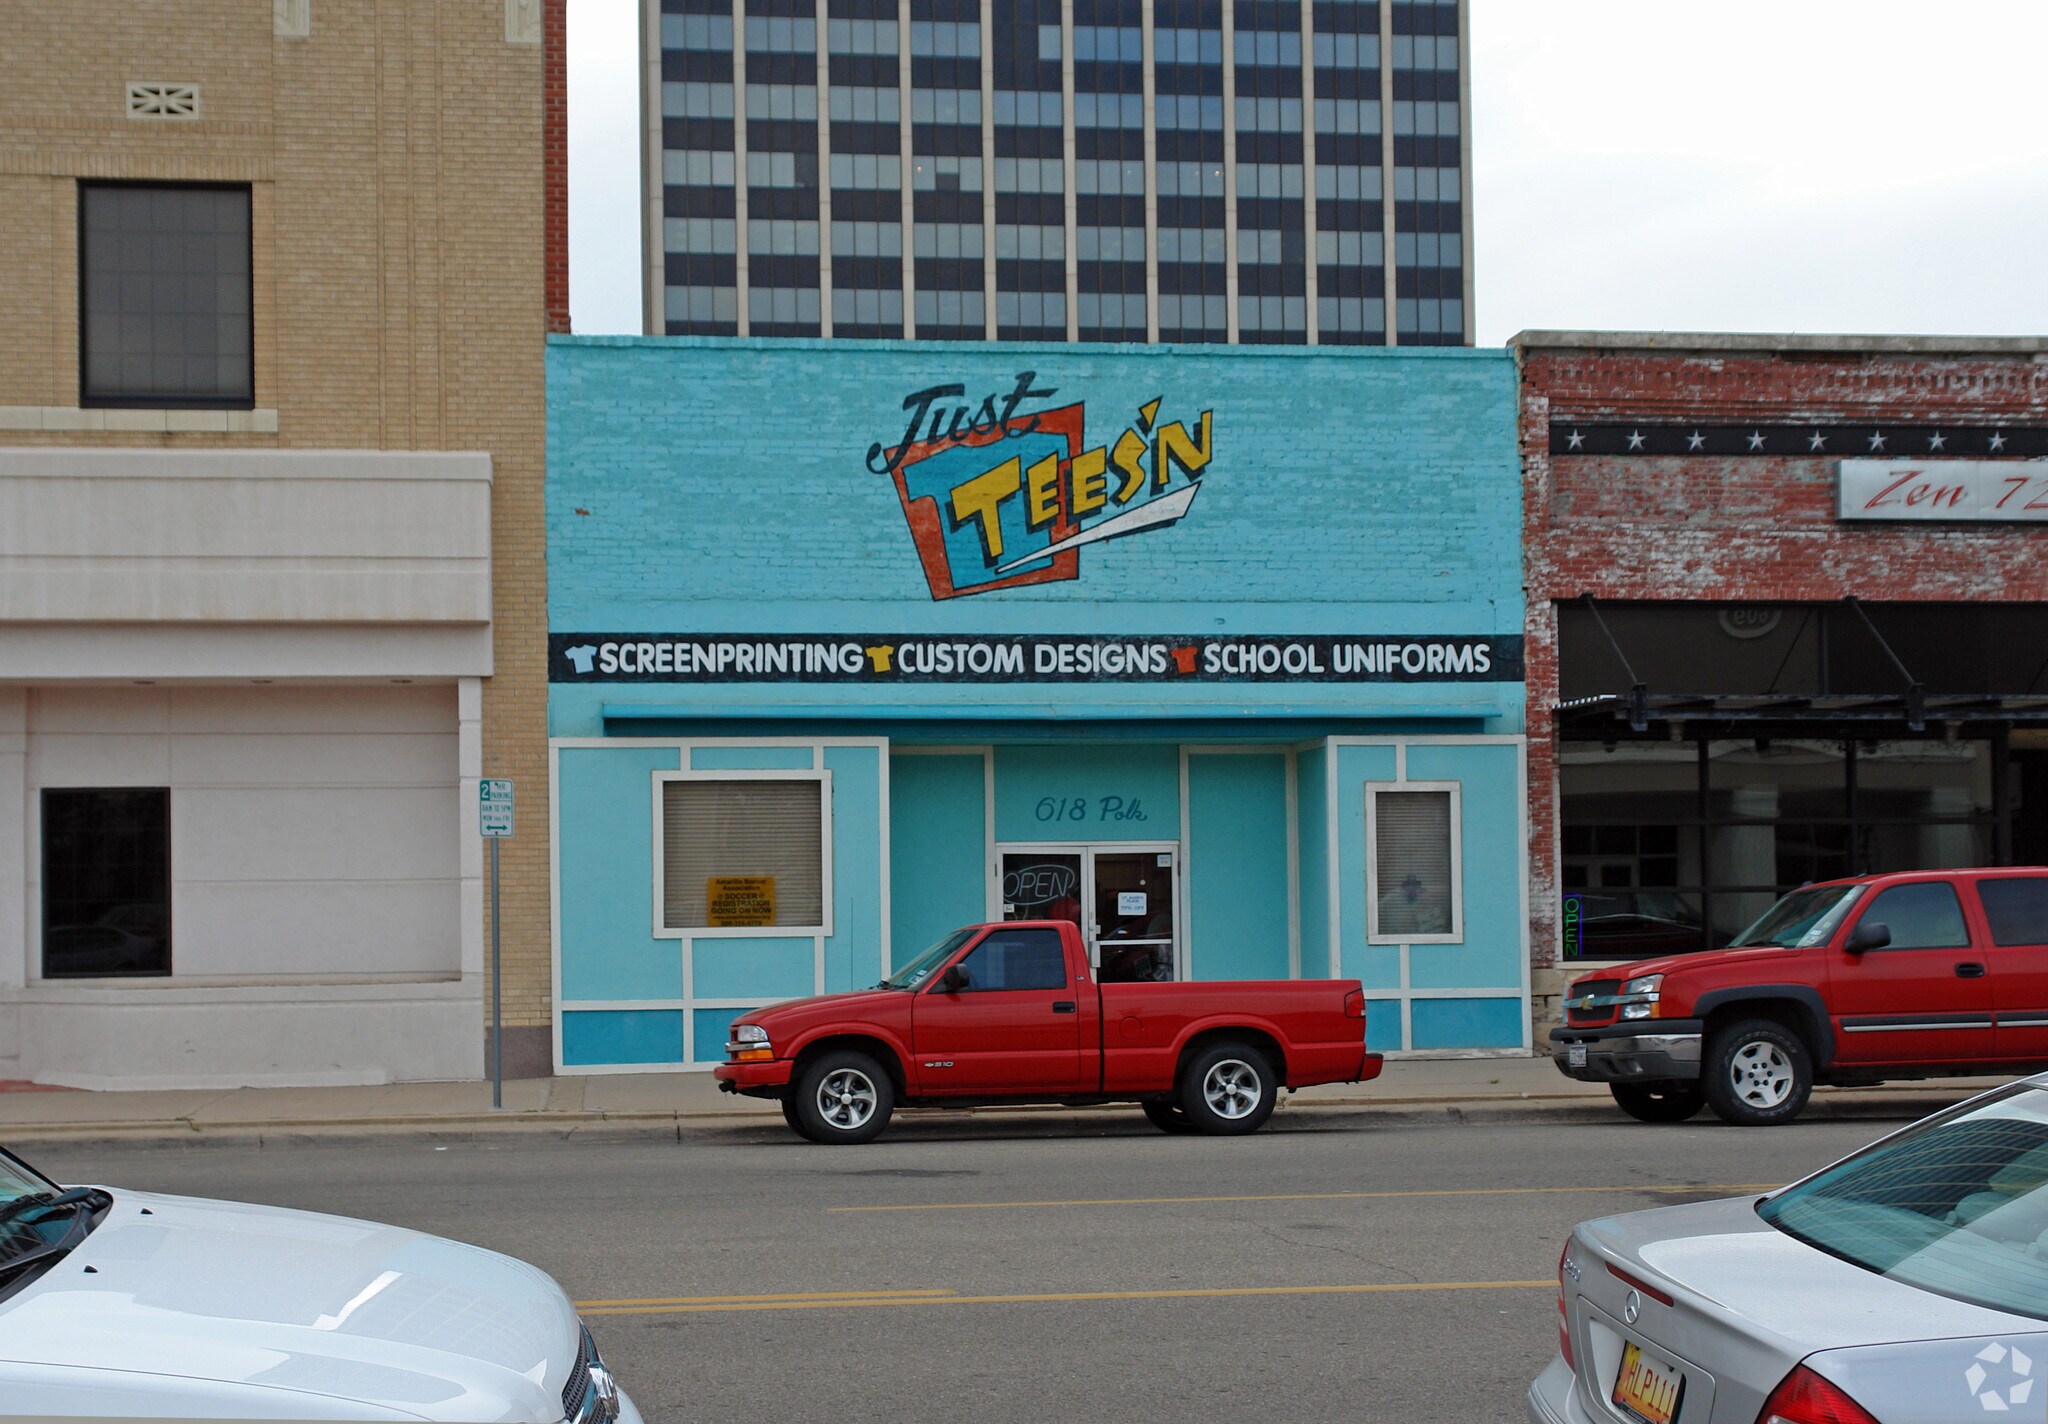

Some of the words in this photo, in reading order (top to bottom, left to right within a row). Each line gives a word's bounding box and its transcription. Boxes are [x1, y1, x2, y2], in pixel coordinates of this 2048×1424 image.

[866, 371, 1059, 474] Just
[1864, 470, 1969, 510] Zen
[599, 642, 865, 674] SCREENPRINTING
[898, 643, 1024, 674] CUSTOM
[1034, 643, 1167, 674] DESIGNS
[1204, 643, 1325, 674] SCHOOL
[1332, 643, 1491, 674] UNIFORMS
[481, 783, 489, 799] 2
[1035, 796, 1087, 822] 618
[1100, 796, 1148, 822] Polk
[1003, 872, 1069, 898] OPEN
[1564, 897, 1580, 957] OPEN
